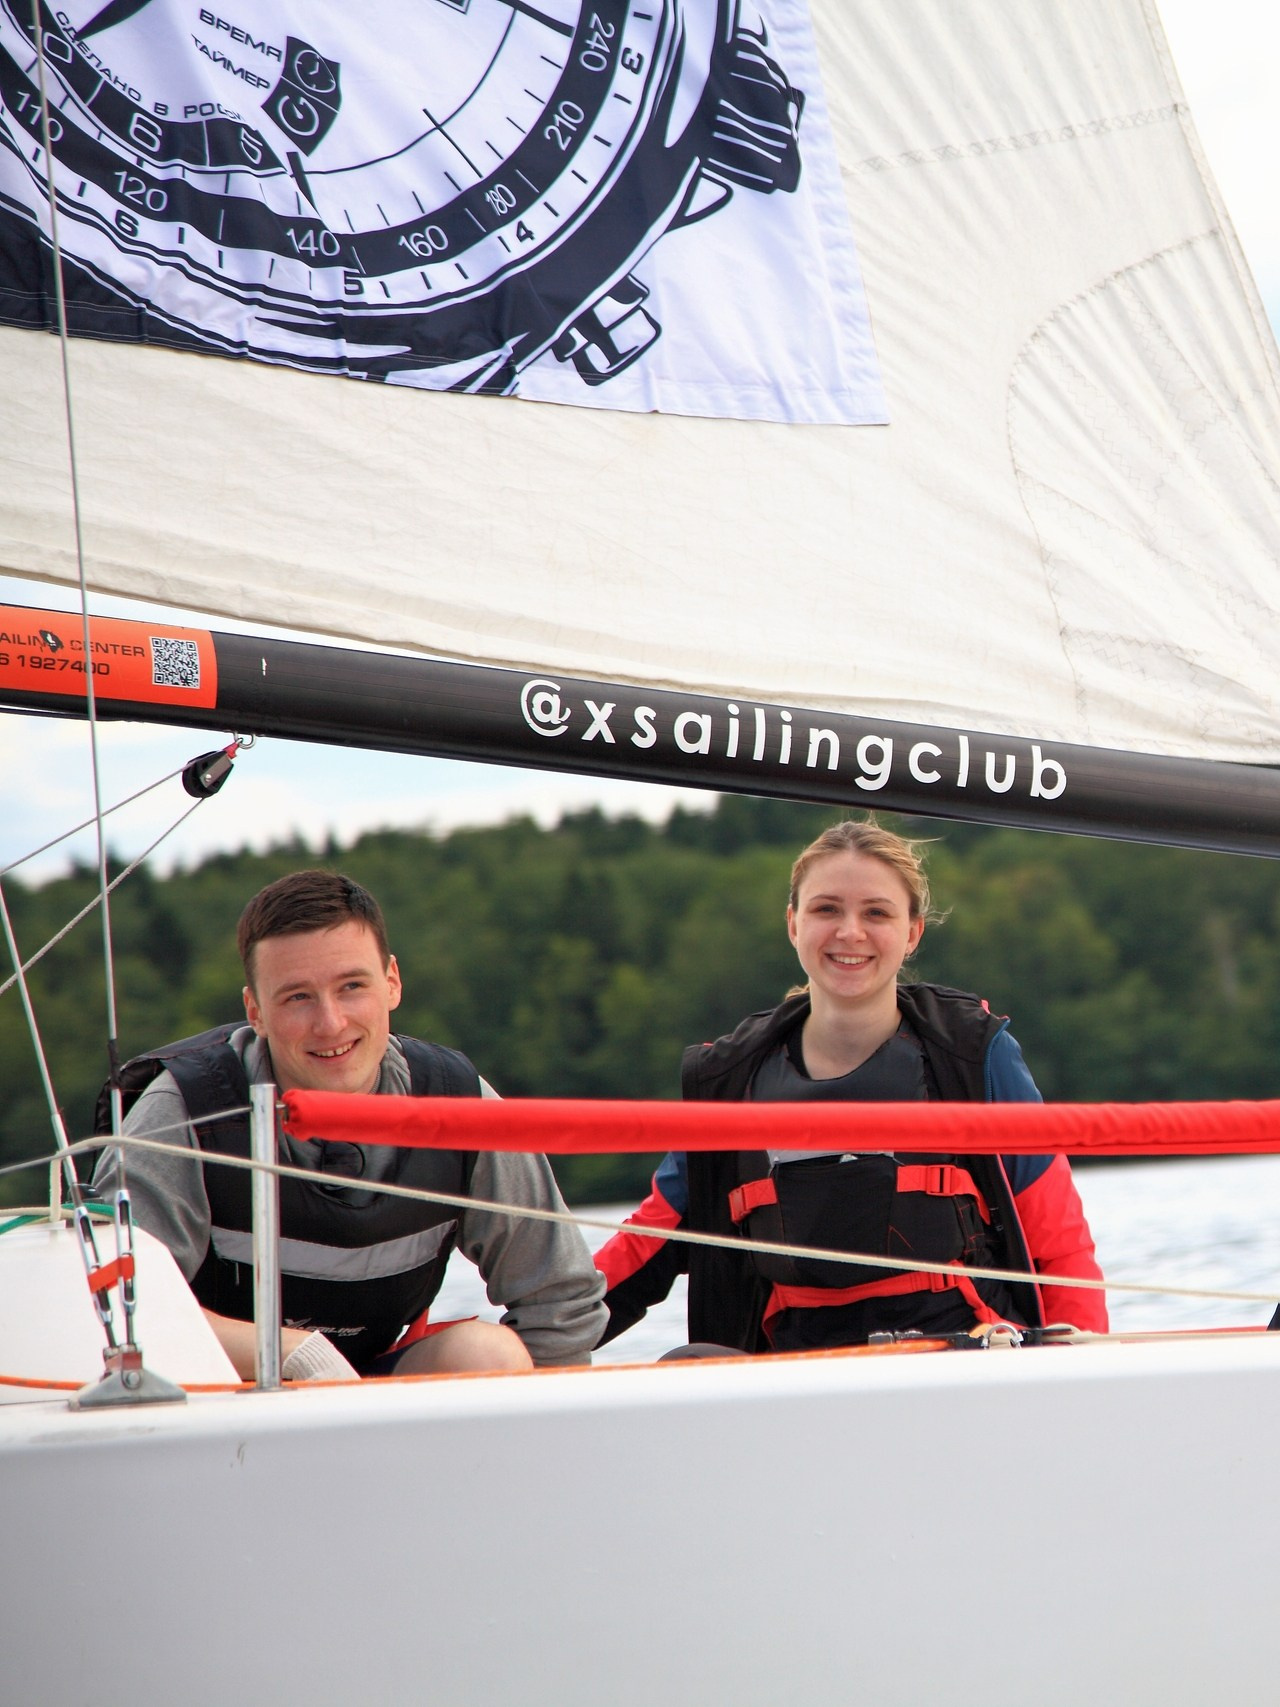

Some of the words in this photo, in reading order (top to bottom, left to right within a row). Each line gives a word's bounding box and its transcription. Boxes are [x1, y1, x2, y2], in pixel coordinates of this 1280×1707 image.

[191, 33, 270, 89] ТАЙМЕР
[199, 8, 283, 62] ВРЕМЯ
[56, 11, 142, 102] СДЕЛАНО
[153, 102, 169, 116] В
[17, 91, 64, 142] 110
[114, 170, 168, 212] 120
[286, 228, 341, 257] 140
[400, 225, 449, 257] 160
[485, 183, 517, 216] 180
[545, 100, 585, 151] 210
[579, 12, 615, 72] 240
[129, 112, 163, 153] 6
[114, 209, 140, 237] 6
[343, 270, 365, 295] 5
[515, 221, 535, 242] 4
[621, 47, 643, 75] 3
[0, 632, 48, 649] AILIN
[69, 639, 146, 657] CENTER
[17, 654, 110, 676] 1927400
[520, 679, 1067, 801] @xsailingclub
